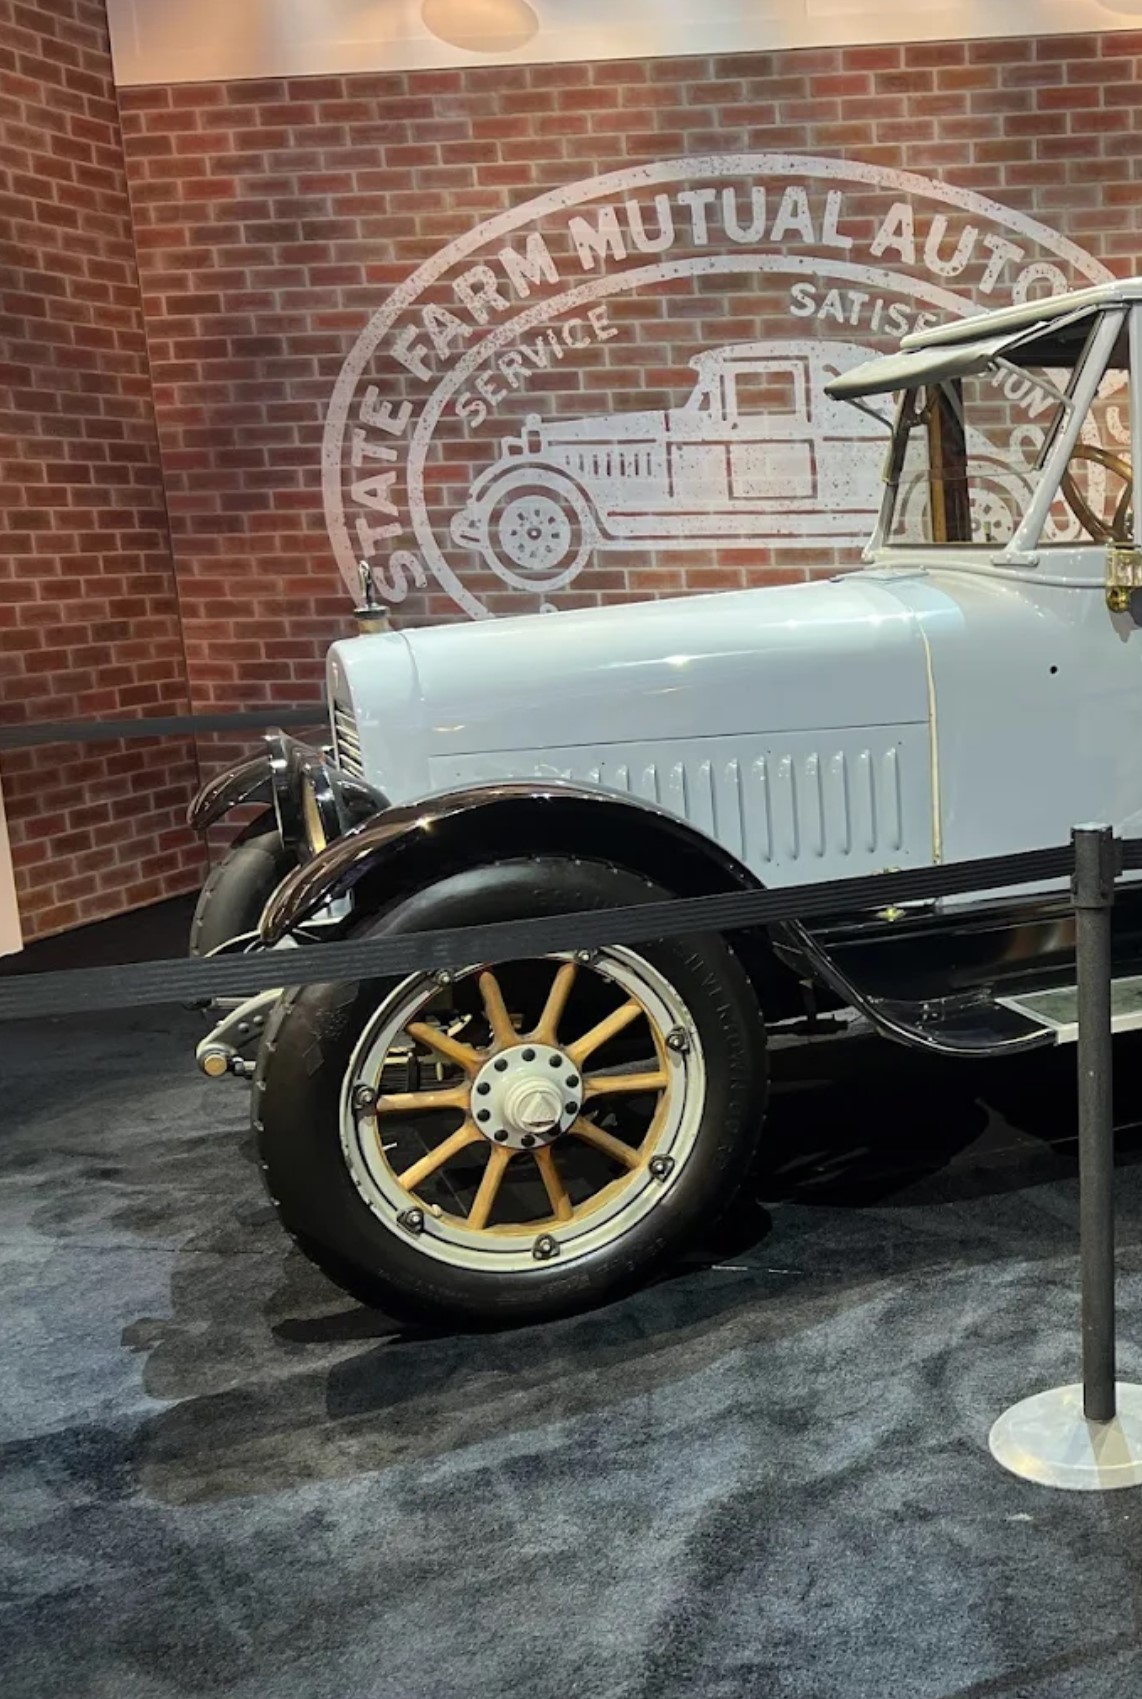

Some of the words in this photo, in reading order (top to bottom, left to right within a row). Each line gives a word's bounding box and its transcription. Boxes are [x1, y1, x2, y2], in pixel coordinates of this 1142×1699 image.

[351, 385, 428, 602] STATE
[390, 231, 560, 382] FARM
[568, 185, 854, 270] MUTUAL
[869, 202, 1068, 306] AUTO
[455, 305, 618, 428] SERVICE
